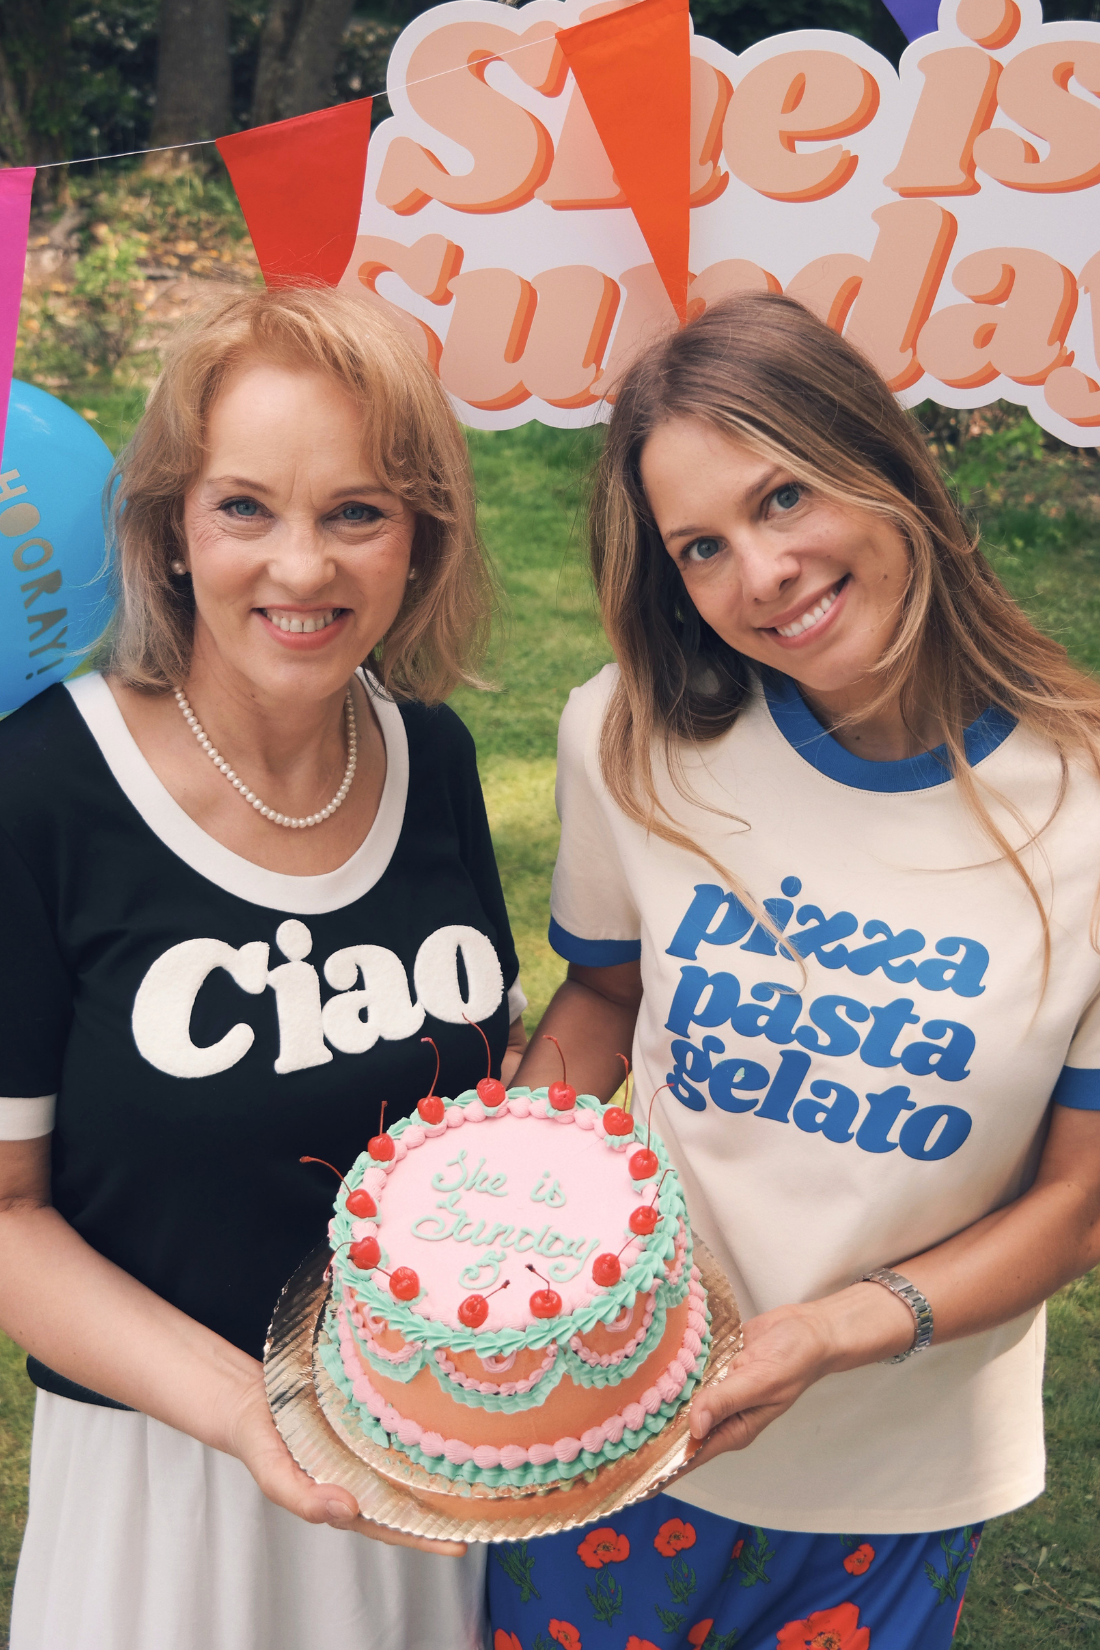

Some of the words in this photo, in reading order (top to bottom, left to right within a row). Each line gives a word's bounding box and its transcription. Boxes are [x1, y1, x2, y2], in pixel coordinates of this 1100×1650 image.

[883, 0, 1100, 197] is
[665, 876, 990, 997] pizza
[132, 919, 503, 1078] Ciao
[664, 965, 976, 1082] pasta
[666, 1035, 973, 1161] gelato
[412, 1192, 600, 1283] Sunday
[431, 1149, 508, 1197] She
[530, 1170, 566, 1208] is
